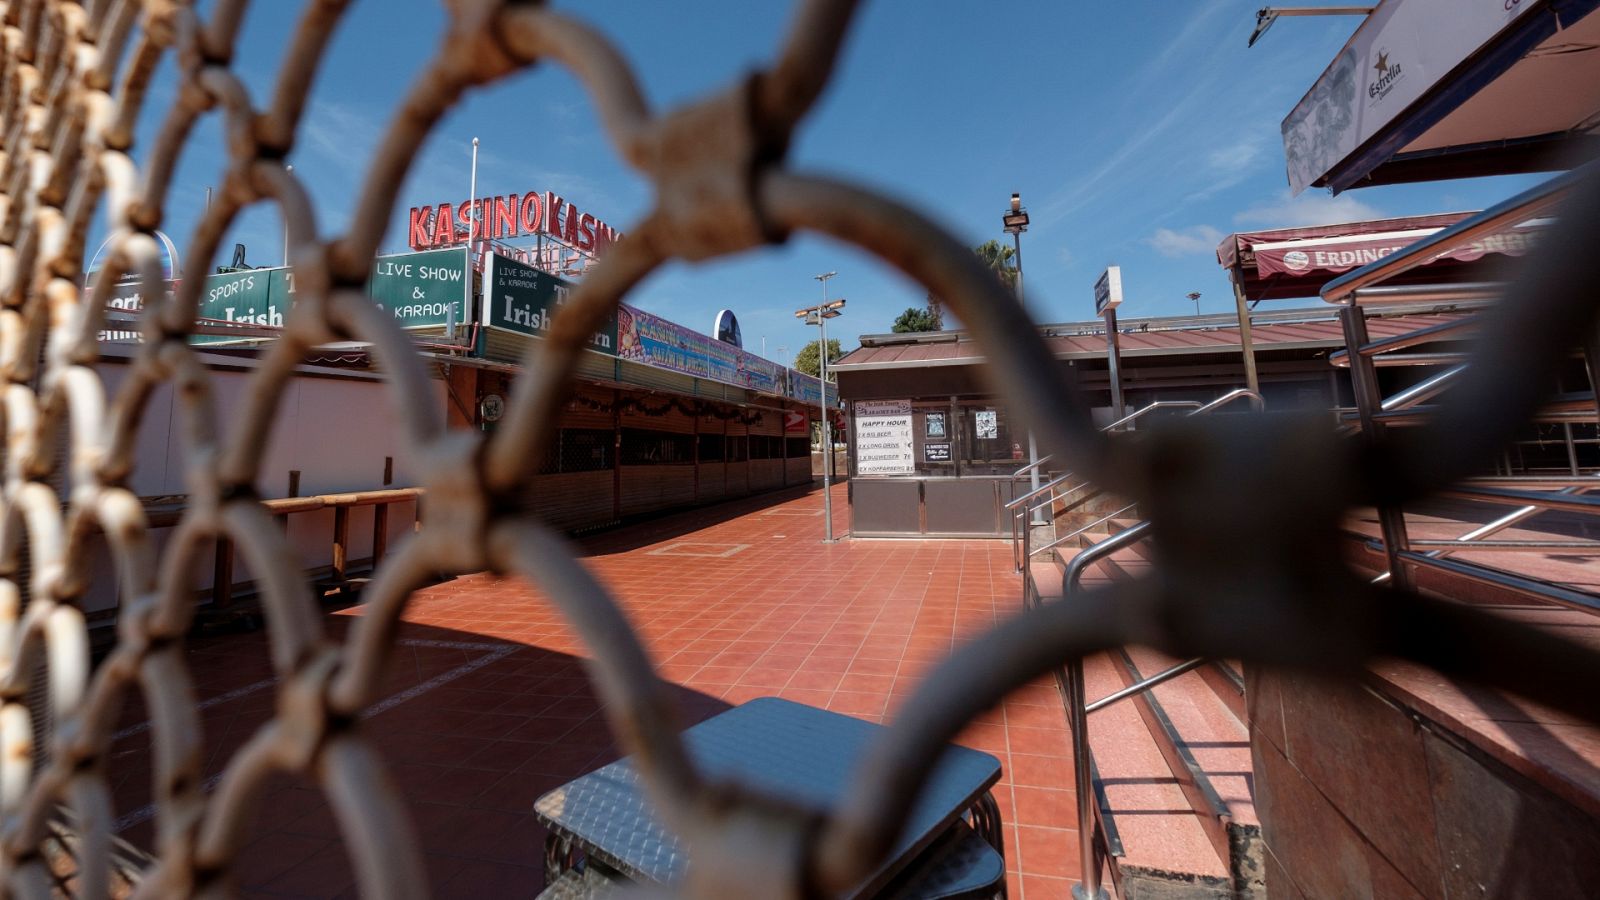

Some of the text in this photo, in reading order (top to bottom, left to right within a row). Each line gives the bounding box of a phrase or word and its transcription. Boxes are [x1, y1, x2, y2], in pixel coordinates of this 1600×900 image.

[409, 191, 542, 251] KASINO
[545, 191, 625, 256] KASIN
[377, 262, 462, 282] LIVE SHOW
[499, 267, 539, 279] LIVE SHOW
[209, 276, 255, 303] SPORTS
[412, 286, 425, 299] &
[508, 279, 537, 290] KARAOKE
[225, 305, 284, 328] Irish
[503, 294, 551, 331] Irish
[861, 420, 885, 428] HAPPY
